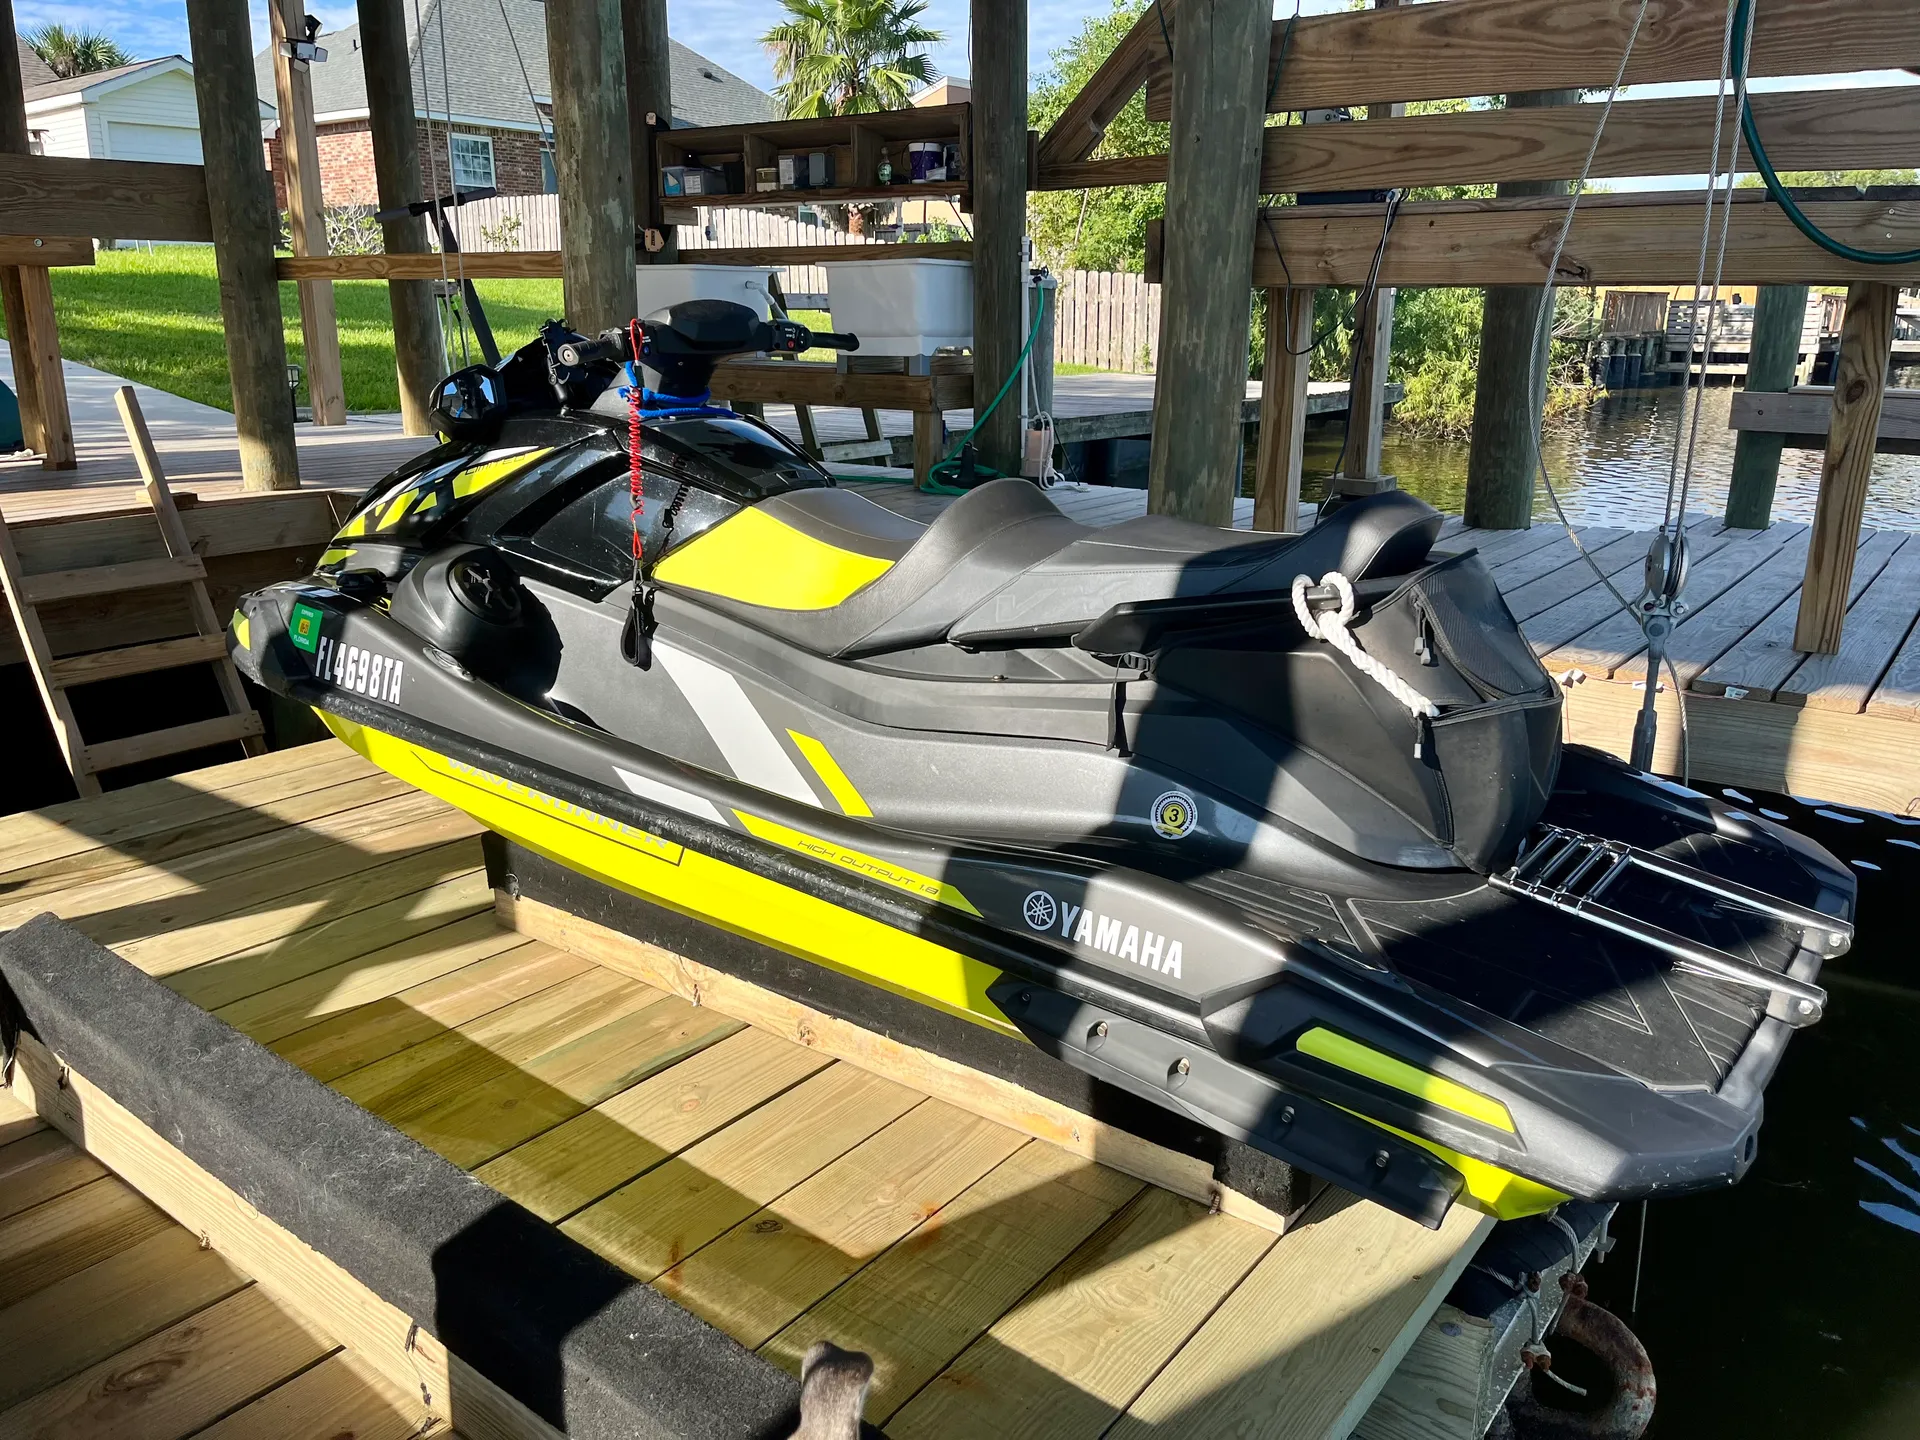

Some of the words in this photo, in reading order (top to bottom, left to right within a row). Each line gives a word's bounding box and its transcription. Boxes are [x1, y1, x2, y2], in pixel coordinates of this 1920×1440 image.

[293, 634, 310, 646] FLORIDA
[447, 758, 668, 848] WAVERUNNER
[1168, 808, 1179, 822] 3
[798, 840, 836, 858] HIGH
[840, 856, 915, 883] OUTPUT
[918, 884, 938, 895] 1.8
[1061, 901, 1183, 979] YAMAHA
